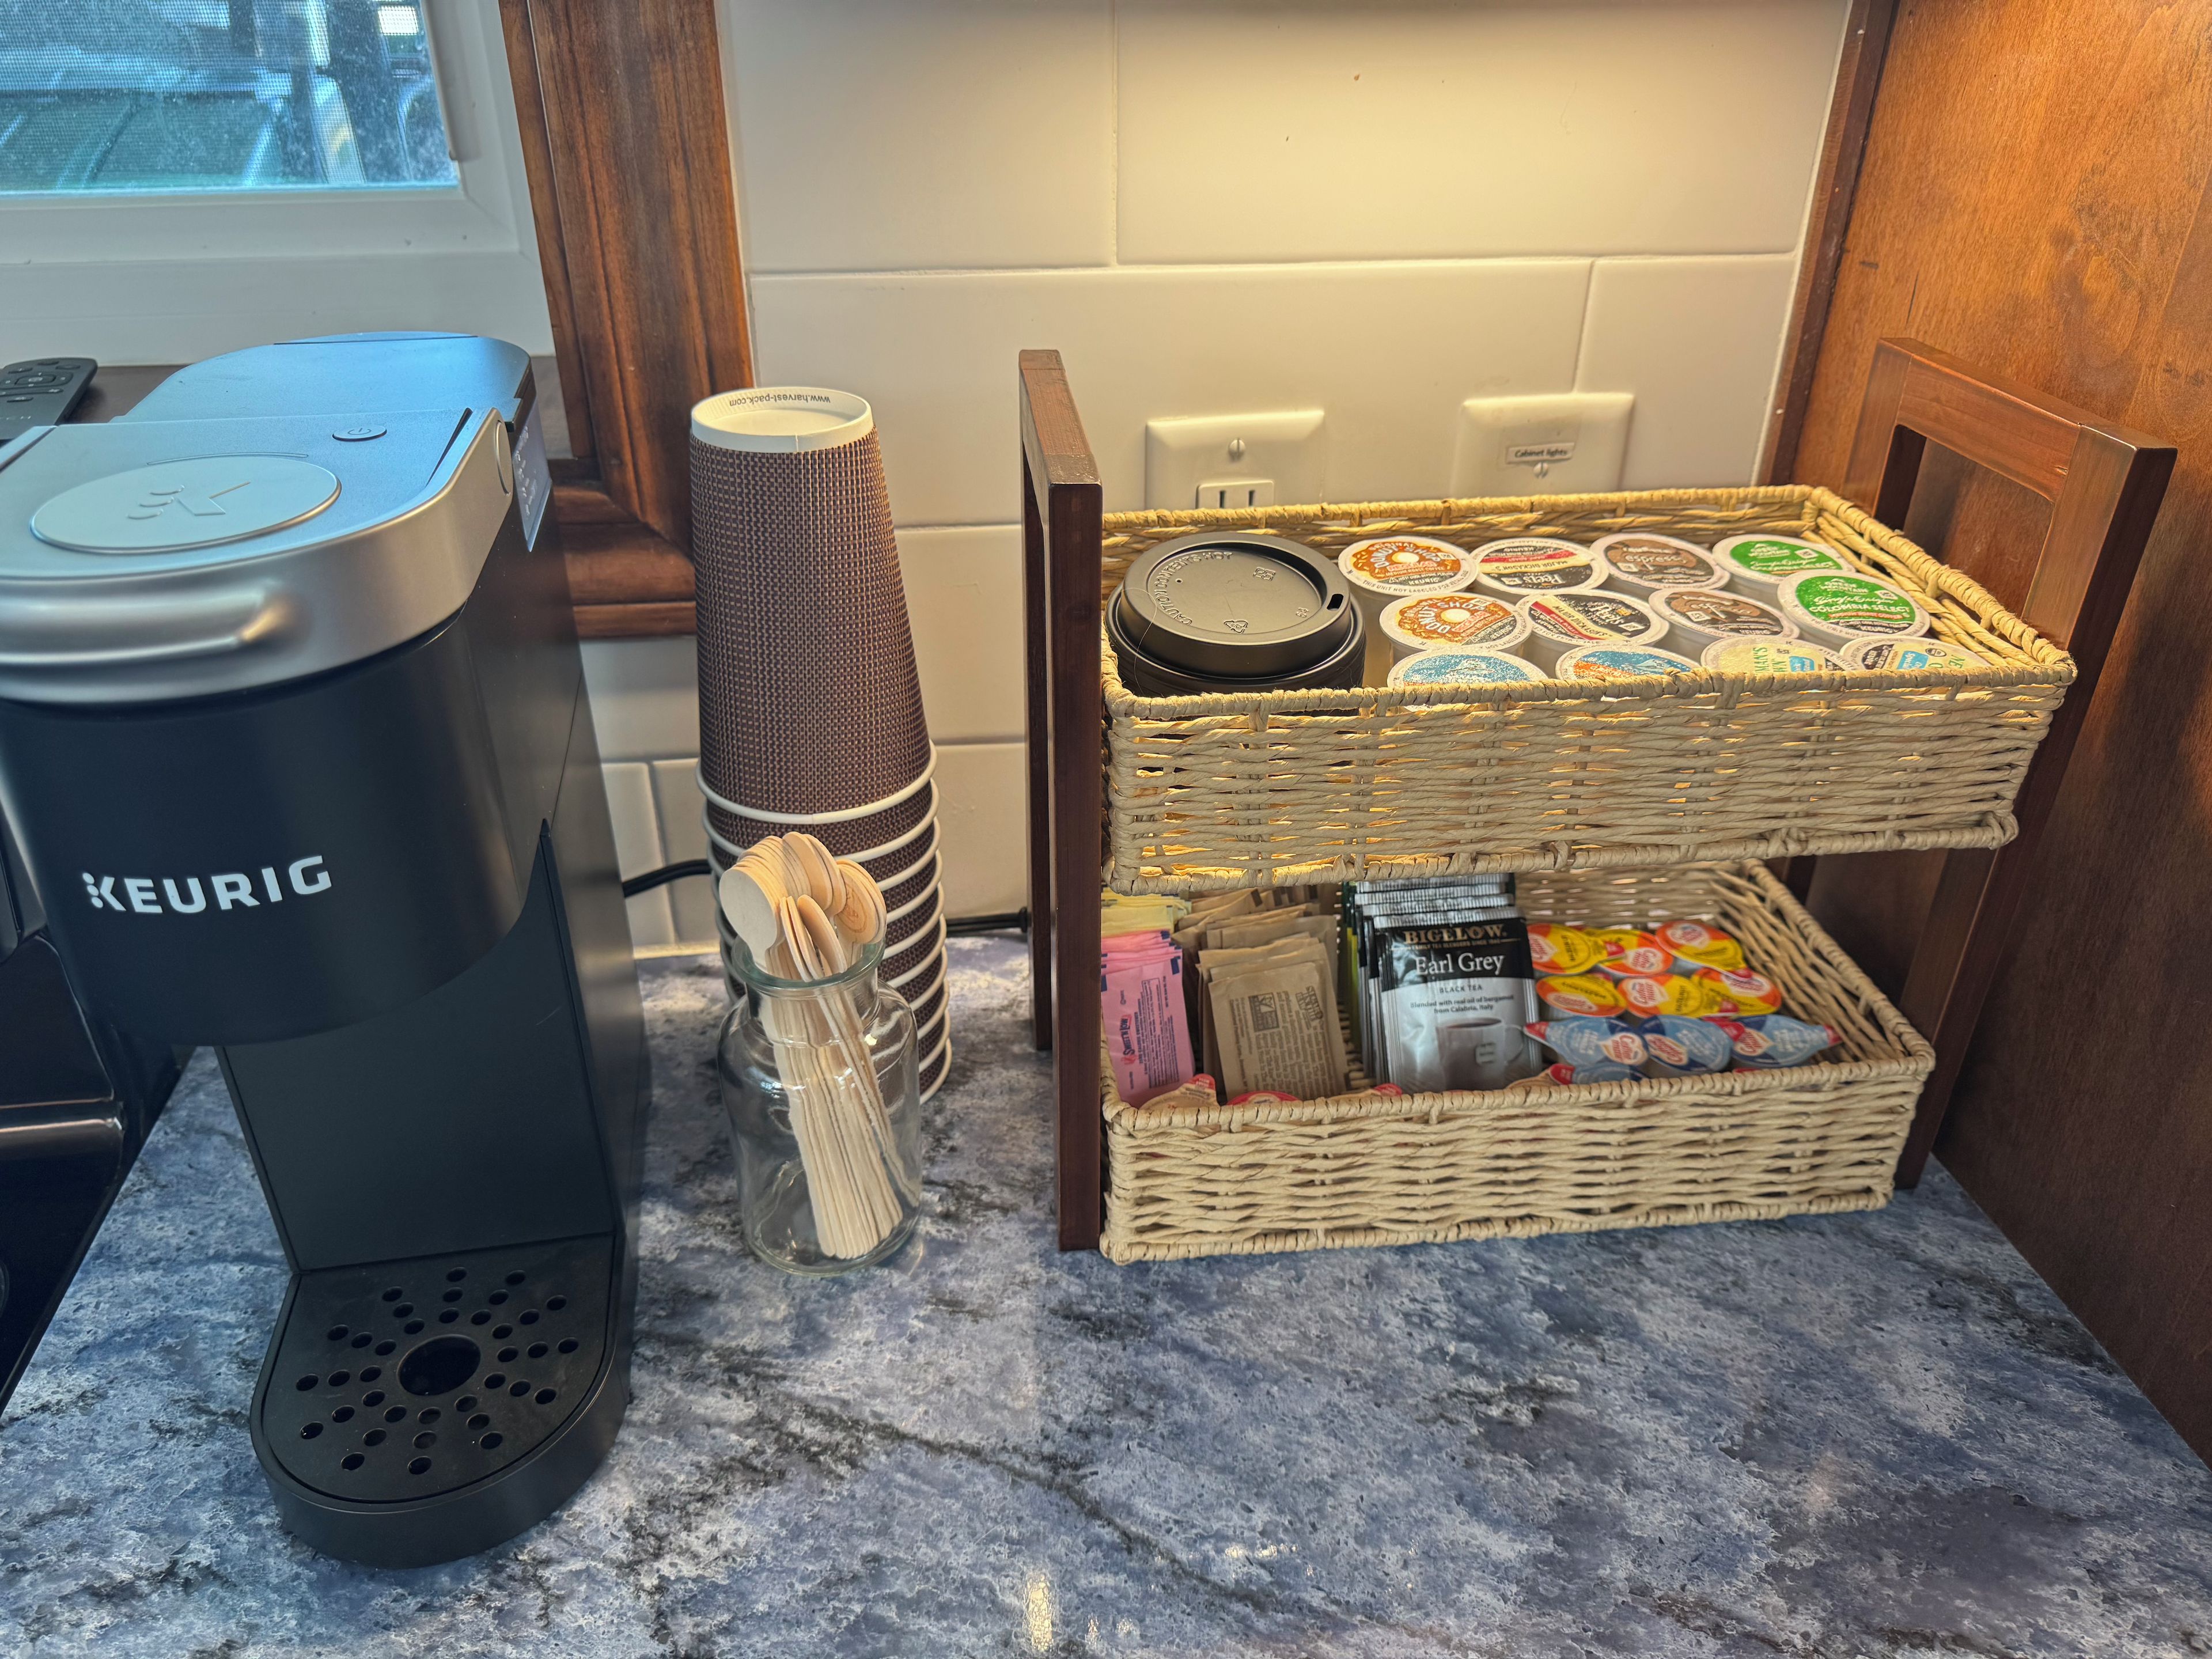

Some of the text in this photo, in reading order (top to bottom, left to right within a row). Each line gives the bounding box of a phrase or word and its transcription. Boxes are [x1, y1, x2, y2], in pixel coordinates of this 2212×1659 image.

[729, 393, 831, 407] www.harvest-pack.com
[1514, 449, 1544, 458] Cabinet
[1369, 542, 1416, 551] ORIGINAL
[1370, 546, 1441, 569] DONUT SHOP
[1495, 560, 1567, 571] MAJOR DICKASON'S
[1408, 577, 1440, 585] KEURIG
[1154, 551, 1233, 626] CAUTION CONTENTS HOT
[1809, 604, 1910, 612] COLOMBIA SELECT
[1418, 606, 1452, 634] DONUT
[1437, 601, 1486, 611] SHOP
[1753, 646, 1770, 673] MAN'S
[82, 855, 332, 914] KEURIG
[1403, 924, 1504, 944] BIGELOW
[1415, 952, 1506, 975] Earl Grey
[1440, 985, 1465, 994] BLACK
[1434, 1006, 1449, 1014] from
